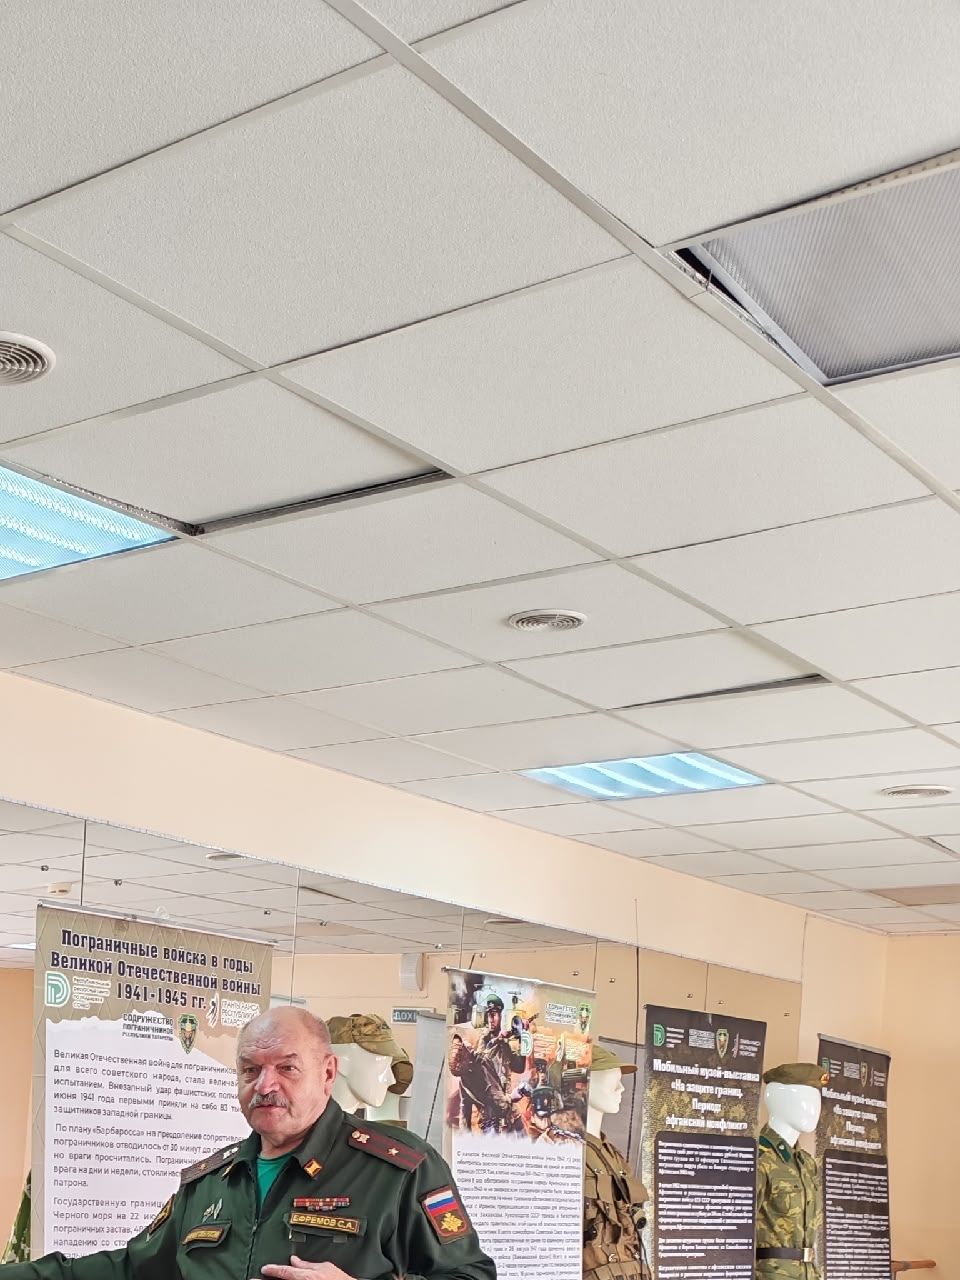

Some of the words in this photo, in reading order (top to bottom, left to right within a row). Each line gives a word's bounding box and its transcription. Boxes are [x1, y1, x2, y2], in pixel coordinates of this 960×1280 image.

[62, 930, 157, 958] Пограничные
[164, 947, 206, 966] войска
[224, 958, 253, 973] годы
[51, 952, 112, 974] Великой
[118, 961, 217, 989] Отечественной
[223, 979, 260, 995] войны
[118, 983, 187, 1006] 1941-1945
[192, 996, 206, 1009] гг.
[123, 1014, 173, 1026] СОДРУЖЕСТВО
[54, 1050, 88, 1059] Великая
[90, 1053, 147, 1065] Отечественная
[102, 1069, 147, 1079] советского
[153, 1073, 181, 1082] народа,
[653, 1059, 699, 1075] Мобильный
[700, 1066, 759, 1081] музей-выставка
[54, 1079, 104, 1089] испытанием.
[109, 1081, 152, 1092] Внезапный
[174, 1086, 216, 1098] фашистских
[671, 1079, 685, 1091] «На
[686, 1084, 714, 1094] защите
[119, 1097, 154, 1107] первыми
[159, 1100, 187, 1108] приняли
[54, 1106, 101, 1115] защитников
[102, 1109, 138, 1118] западной
[666, 1114, 705, 1128] афганский
[707, 1118, 747, 1131] конфликт»
[69, 1125, 91, 1135] плану
[93, 1126, 144, 1136] «Барбаросса»
[54, 1139, 114, 1148] пограничников
[180, 1145, 200, 1154] минут
[69, 1153, 91, 1161] враги
[95, 1154, 151, 1163] просчитались.
[111, 1168, 140, 1176] недели,
[54, 1179, 88, 1188] патрона.
[54, 1197, 126, 1208] Государственную
[53, 1211, 89, 1220] Черного
[93, 1212, 112, 1220] моря
[293, 1214, 336, 1227] ЕФРЕМОВ
[337, 1221, 354, 1229] С.А.
[54, 1226, 104, 1234] пограничных
[106, 1226, 132, 1234] застав,
[54, 1239, 97, 1247] нападению
